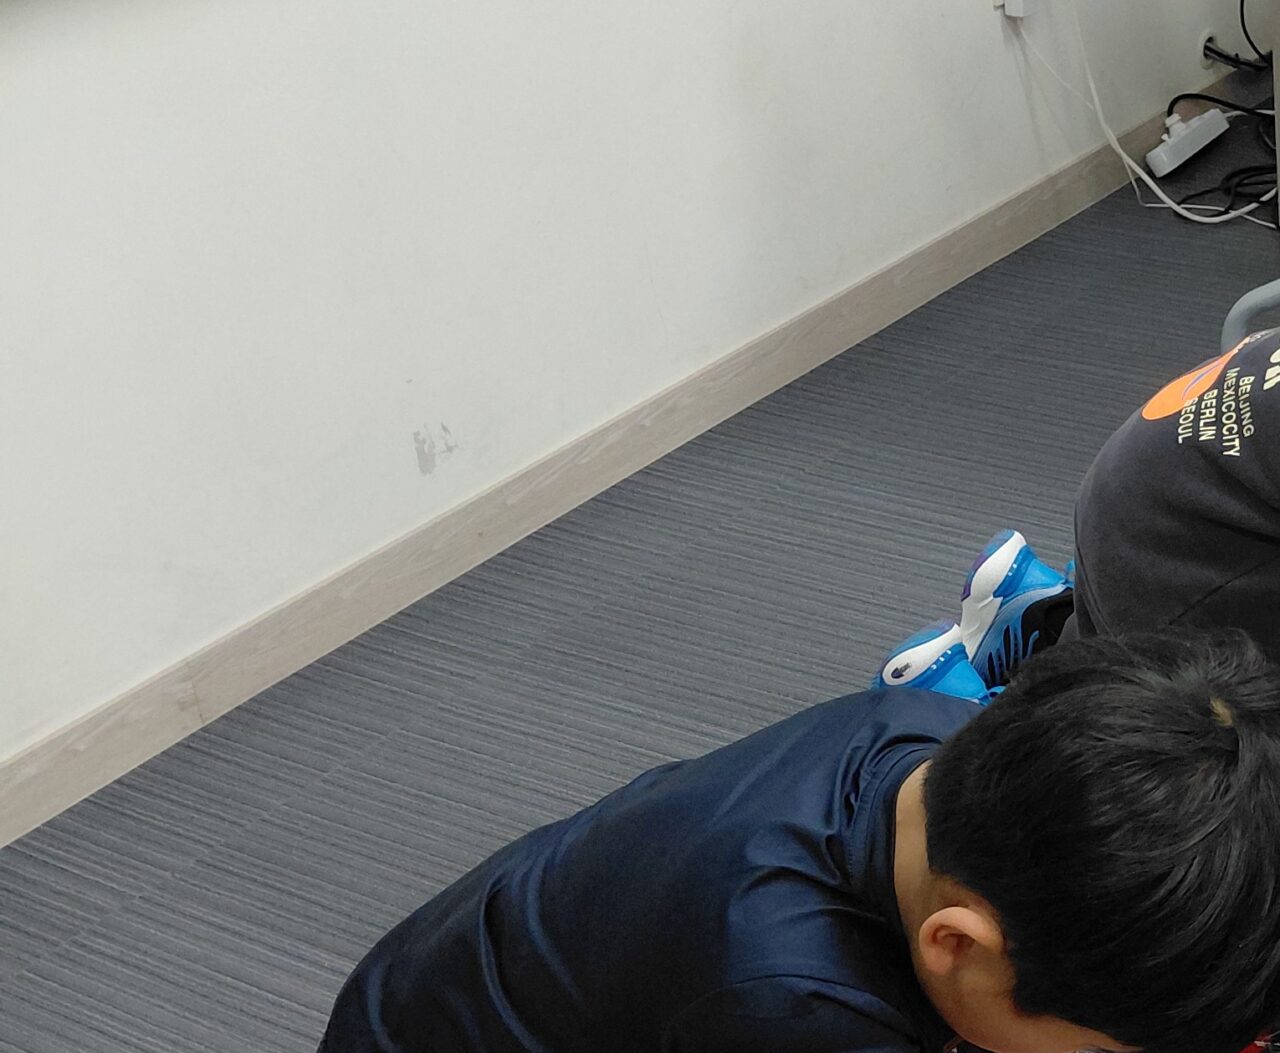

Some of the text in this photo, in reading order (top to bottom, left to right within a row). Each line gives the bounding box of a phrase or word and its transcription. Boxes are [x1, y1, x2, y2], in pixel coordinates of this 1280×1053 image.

[1178, 396, 1199, 444] SEOUL
[1199, 388, 1219, 442] BERLIN
[1238, 375, 1256, 438] BEIJING
